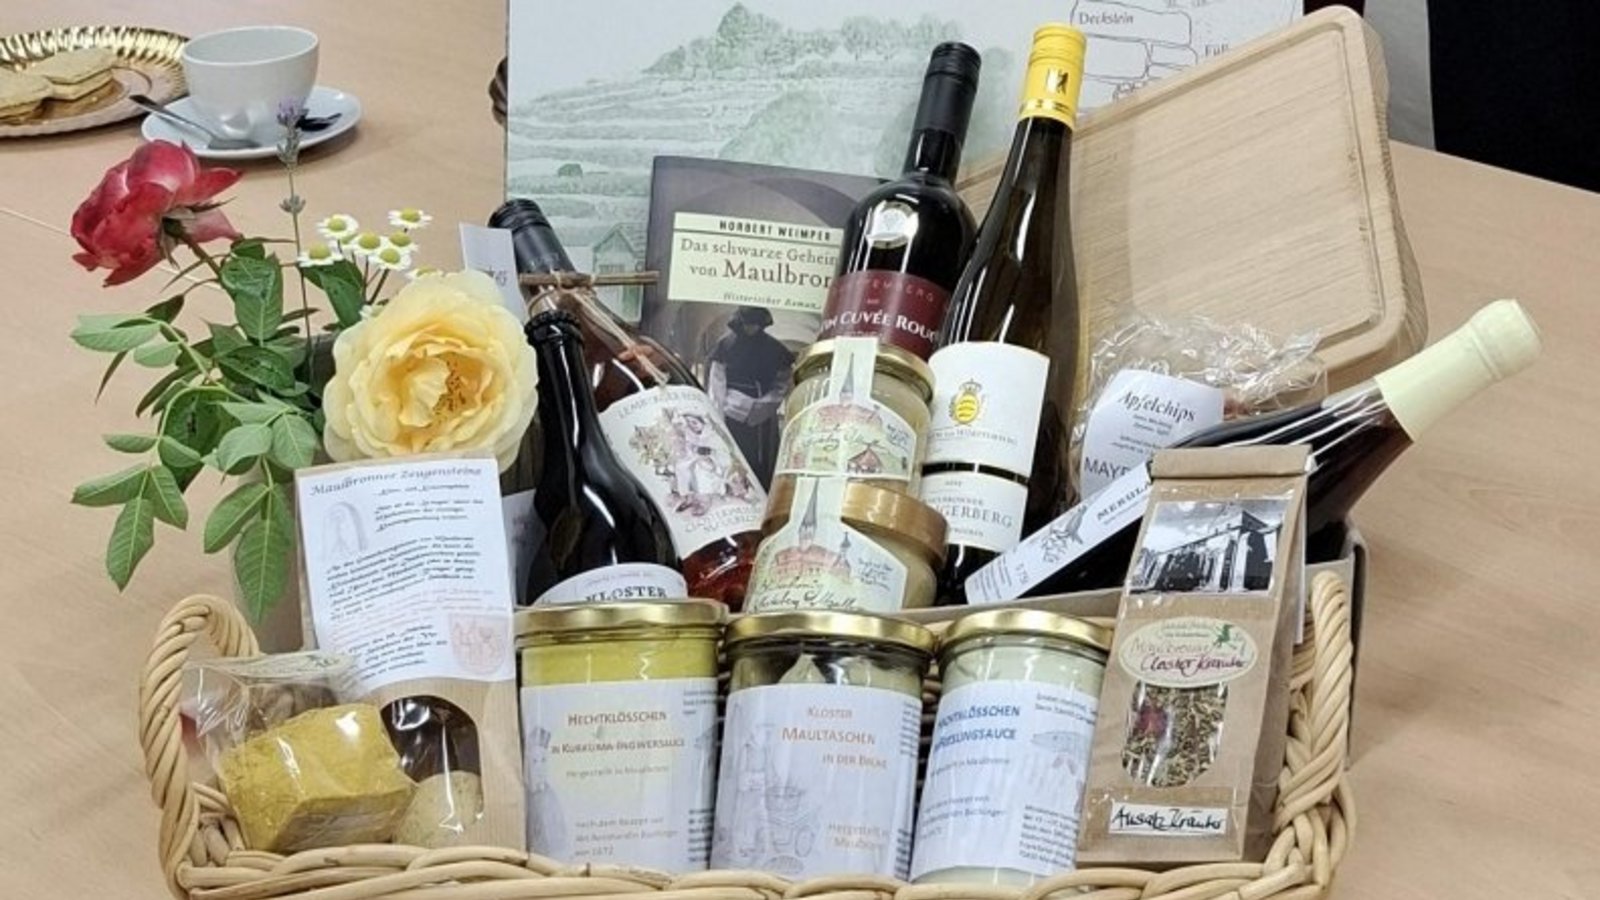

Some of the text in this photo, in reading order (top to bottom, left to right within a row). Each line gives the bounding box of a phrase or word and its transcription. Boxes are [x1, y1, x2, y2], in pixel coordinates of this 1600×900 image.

[1079, 11, 1134, 26] Deckstein
[718, 219, 773, 235] NORBERT
[680, 238, 709, 252] Das
[712, 240, 783, 261] schwarze
[689, 265, 718, 278] von
[840, 308, 892, 327] CUVÉE
[1116, 390, 1197, 423] Apfelchips
[309, 470, 398, 497] Maulbronner
[567, 711, 668, 727] HECHTKLÖSSCHEN
[807, 705, 854, 720] KLOSTER
[781, 726, 876, 746] MAULTASCHEN
[822, 755, 835, 765] IN
[836, 755, 858, 767] DER
